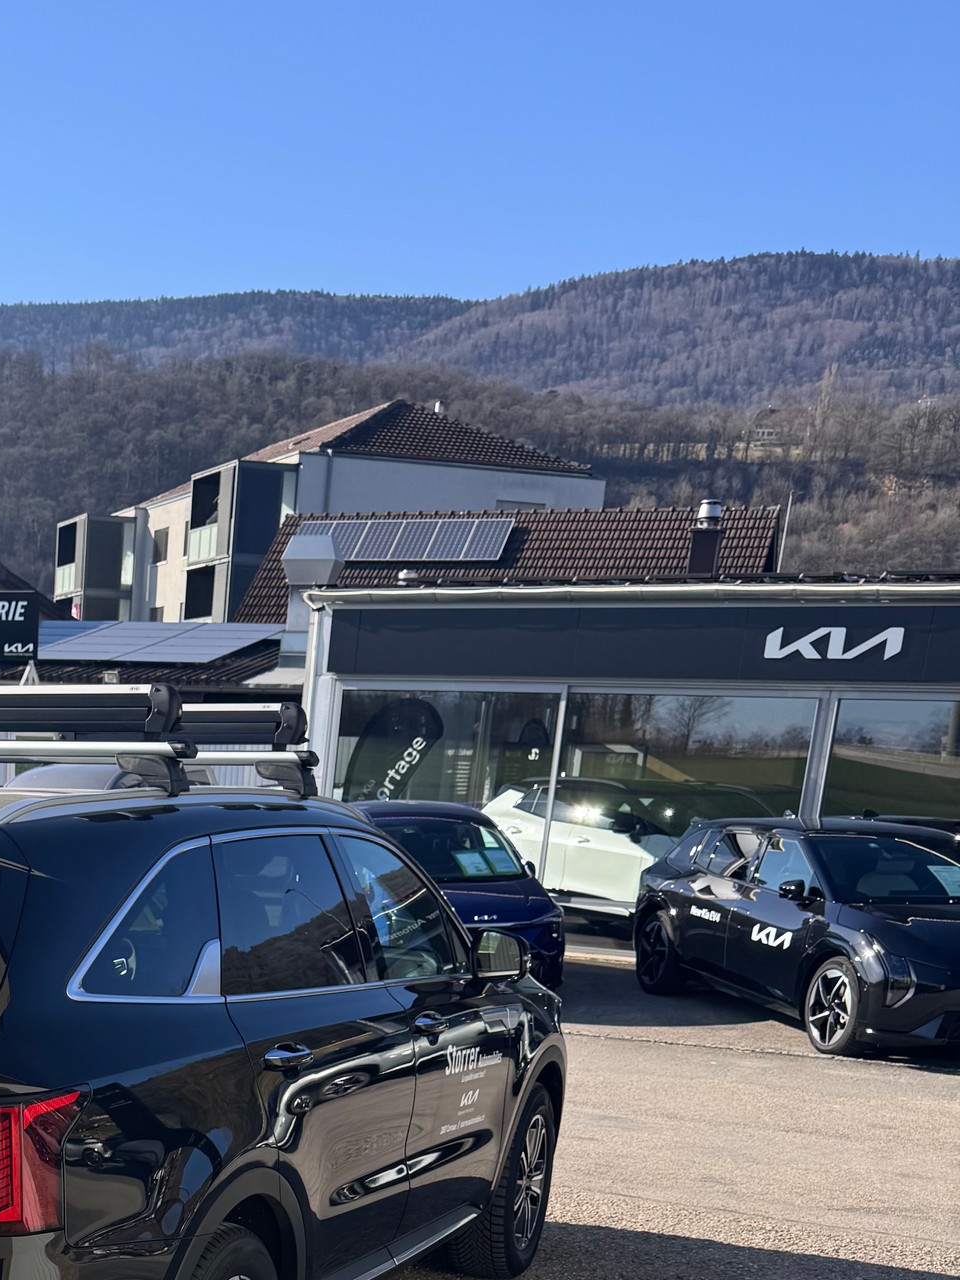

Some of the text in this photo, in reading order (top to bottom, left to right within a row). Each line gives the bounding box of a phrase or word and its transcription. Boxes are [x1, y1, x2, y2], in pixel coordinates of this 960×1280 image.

[3, 642, 34, 653] KIA
[763, 626, 905, 661] KIA
[377, 736, 427, 800] ortage
[750, 923, 793, 950] KIA
[445, 1044, 480, 1075] Storrer
